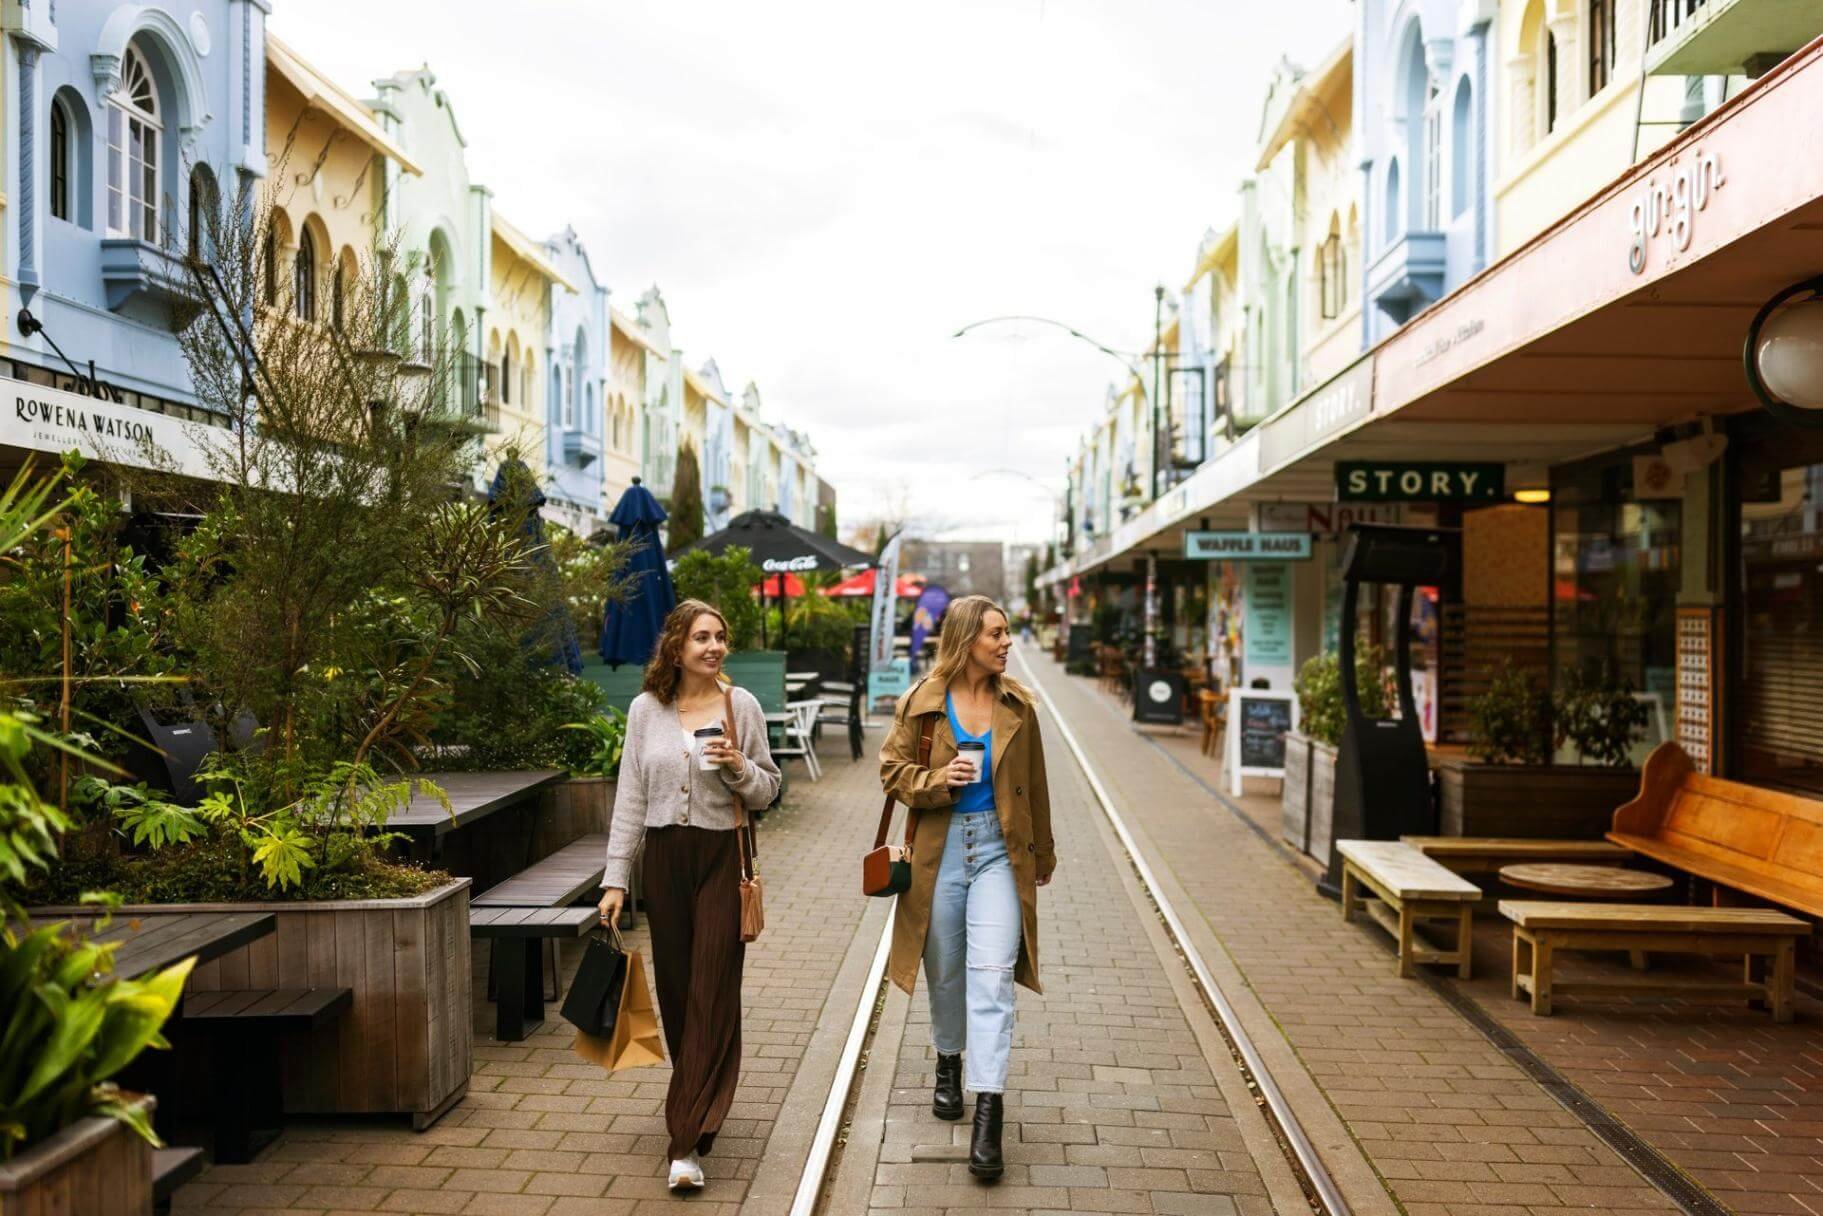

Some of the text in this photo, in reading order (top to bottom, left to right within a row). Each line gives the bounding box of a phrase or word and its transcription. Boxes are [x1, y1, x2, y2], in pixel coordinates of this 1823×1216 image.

[16, 397, 153, 444] ROWENA WATSON
[1348, 469, 1494, 495] STORY.
[1197, 538, 1302, 552] WAFFLE HAUS
